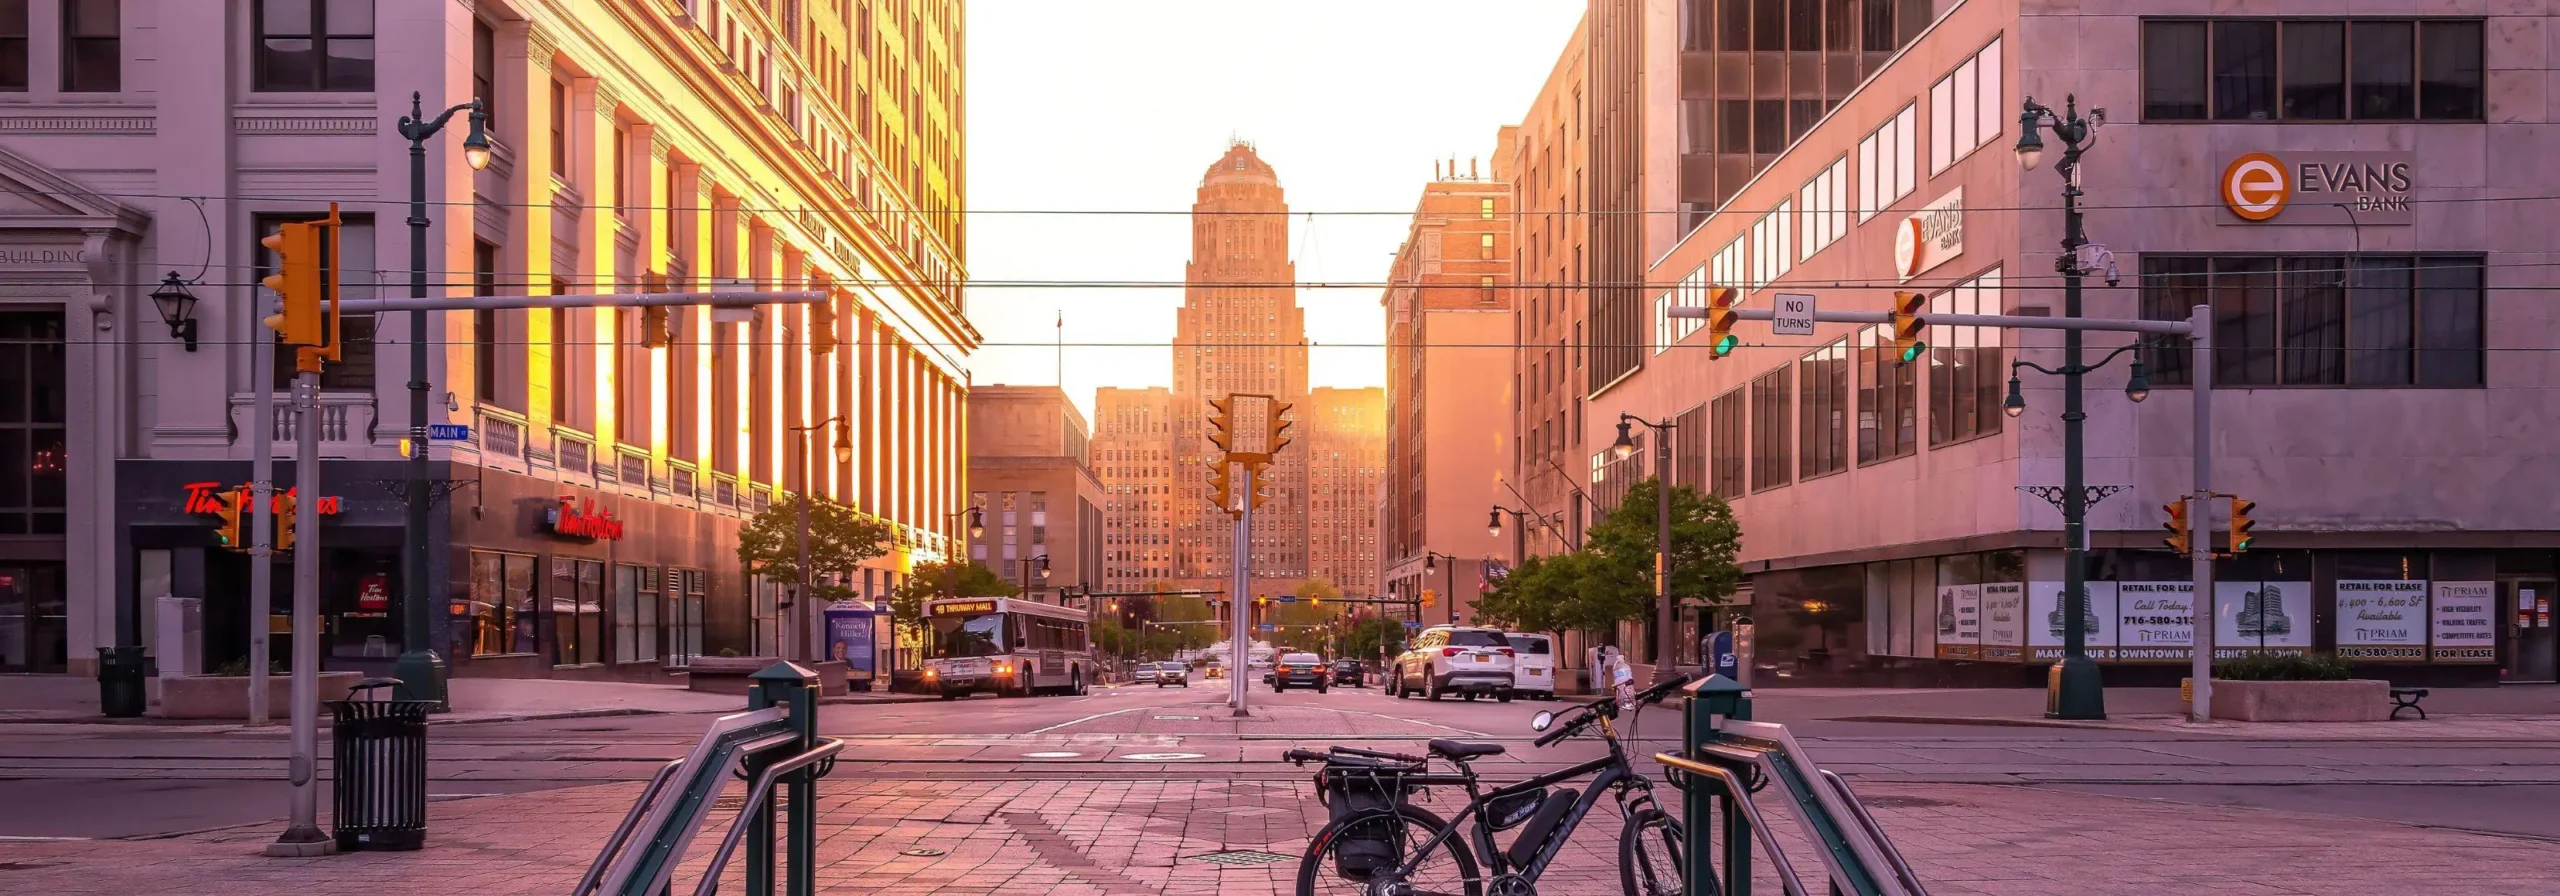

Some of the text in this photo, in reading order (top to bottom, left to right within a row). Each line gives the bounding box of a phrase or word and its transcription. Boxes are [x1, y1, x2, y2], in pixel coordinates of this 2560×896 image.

[2298, 162, 2412, 193] EVANS
[2358, 196, 2410, 212] BANK
[1922, 199, 1961, 242] EVANS
[1940, 228, 1960, 251] BANK
[1786, 300, 1804, 312] NO
[1776, 317, 1811, 329] TURNS
[431, 427, 458, 439] MAIN
[368, 584, 382, 593] Tim
[2122, 584, 2194, 593] RETAIL FOR LEA
[2340, 583, 2423, 591] RETAIL FOR LEASE
[2454, 587, 2488, 596] PRIAM
[360, 592, 388, 602] Hortons
[2377, 596, 2406, 608] 6,600
[2409, 595, 2425, 607] SF
[946, 603, 975, 613] THRUWAY
[976, 602, 992, 611] MALL
[2134, 600, 2156, 610] Call
[2356, 609, 2404, 621] Available
[835, 621, 866, 629] Kenneth
[2123, 616, 2194, 626] 716-580-313
[2153, 630, 2192, 640] PRIAM
[2370, 629, 2408, 638] PRIAM
[2035, 649, 2065, 659] MAK
[2339, 648, 2422, 658] 716-580-3136
[2435, 649, 2493, 658] FOR LEASE
